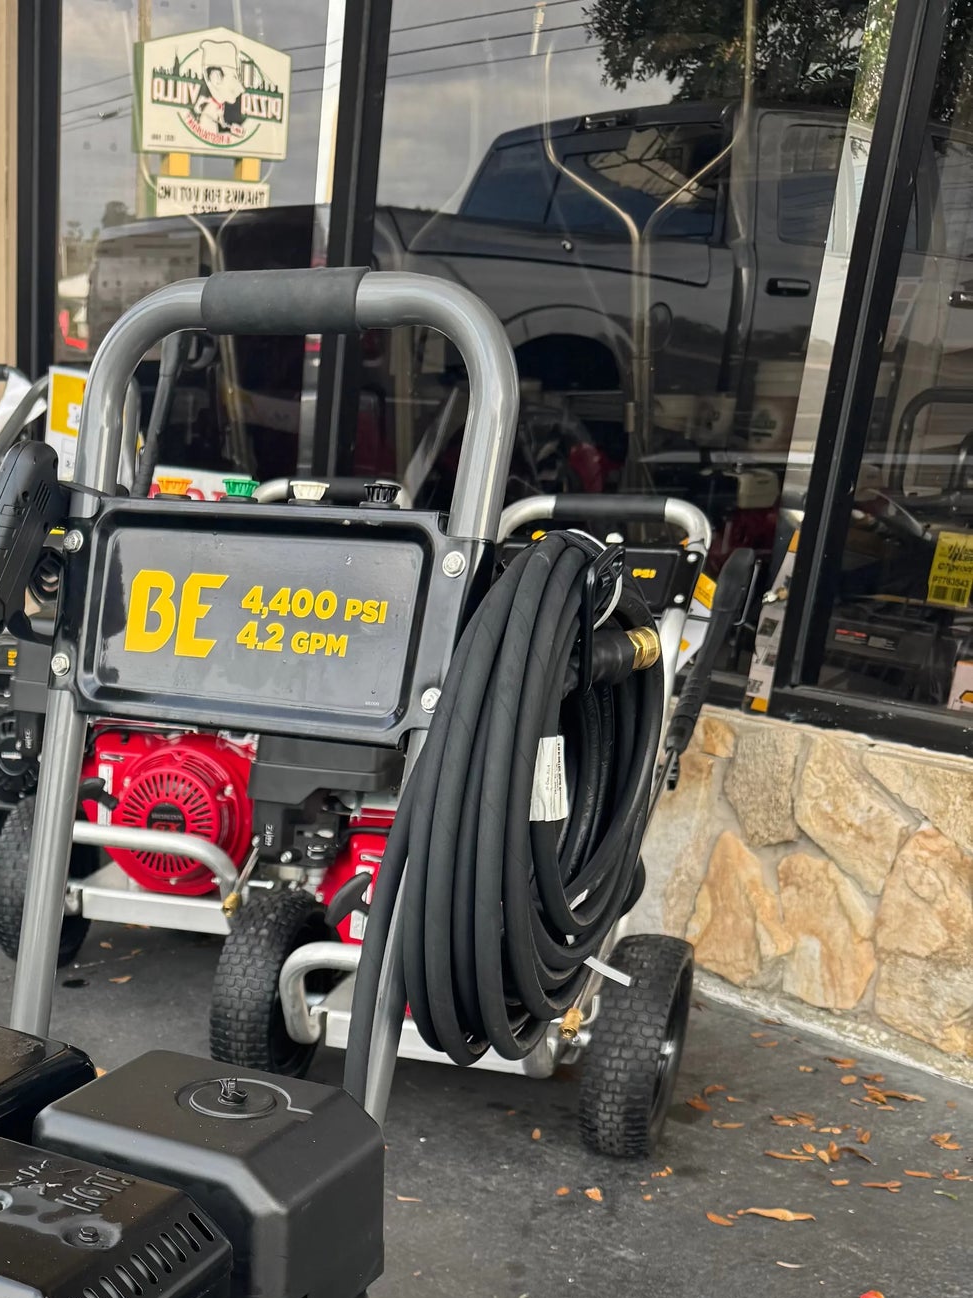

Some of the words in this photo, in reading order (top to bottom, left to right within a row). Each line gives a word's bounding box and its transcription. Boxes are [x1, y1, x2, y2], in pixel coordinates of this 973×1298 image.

[124, 569, 230, 659] BE
[241, 585, 337, 620] 4,400
[344, 598, 388, 625] PSI
[236, 621, 284, 653] 4.2
[290, 631, 349, 658] GPM
